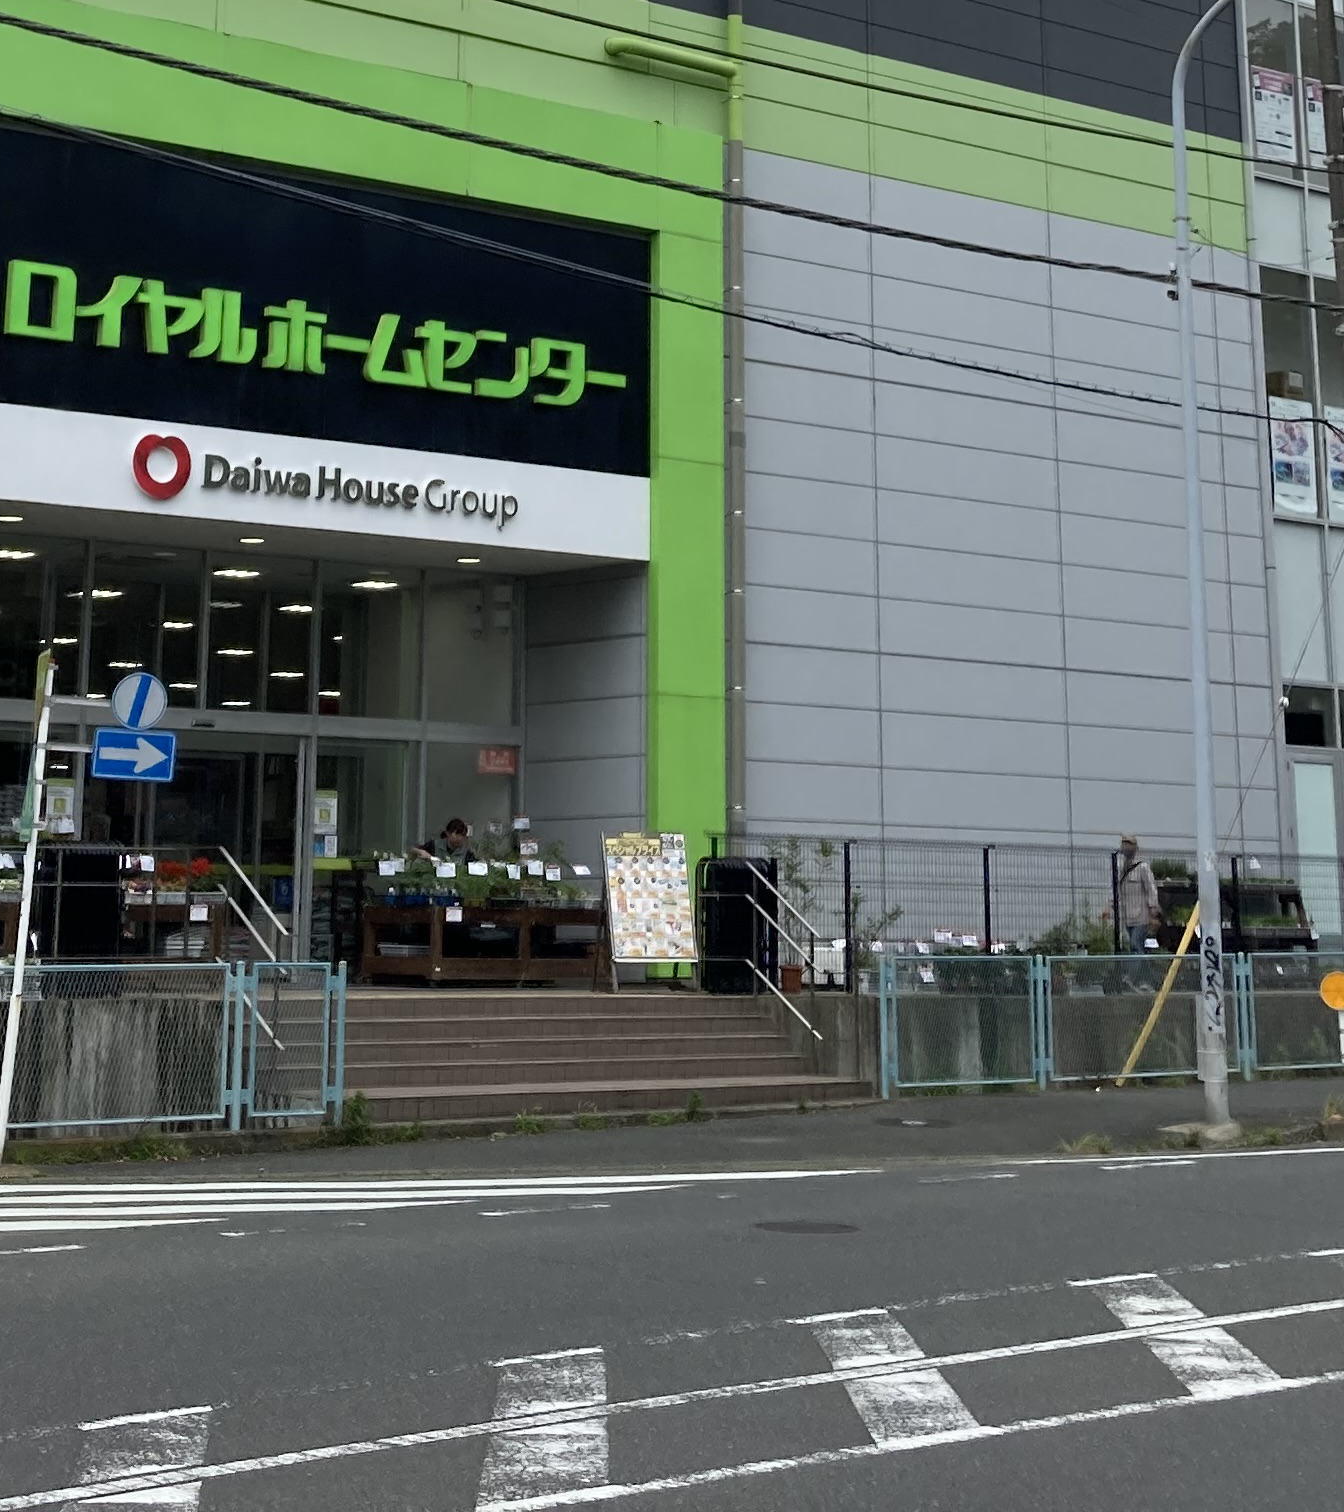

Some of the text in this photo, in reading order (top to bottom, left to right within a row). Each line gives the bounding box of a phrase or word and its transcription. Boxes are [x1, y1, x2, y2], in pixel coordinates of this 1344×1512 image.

[3, 259, 627, 406] ロイヤルホームセンター
[201, 454, 519, 532] Daiwa House Group
